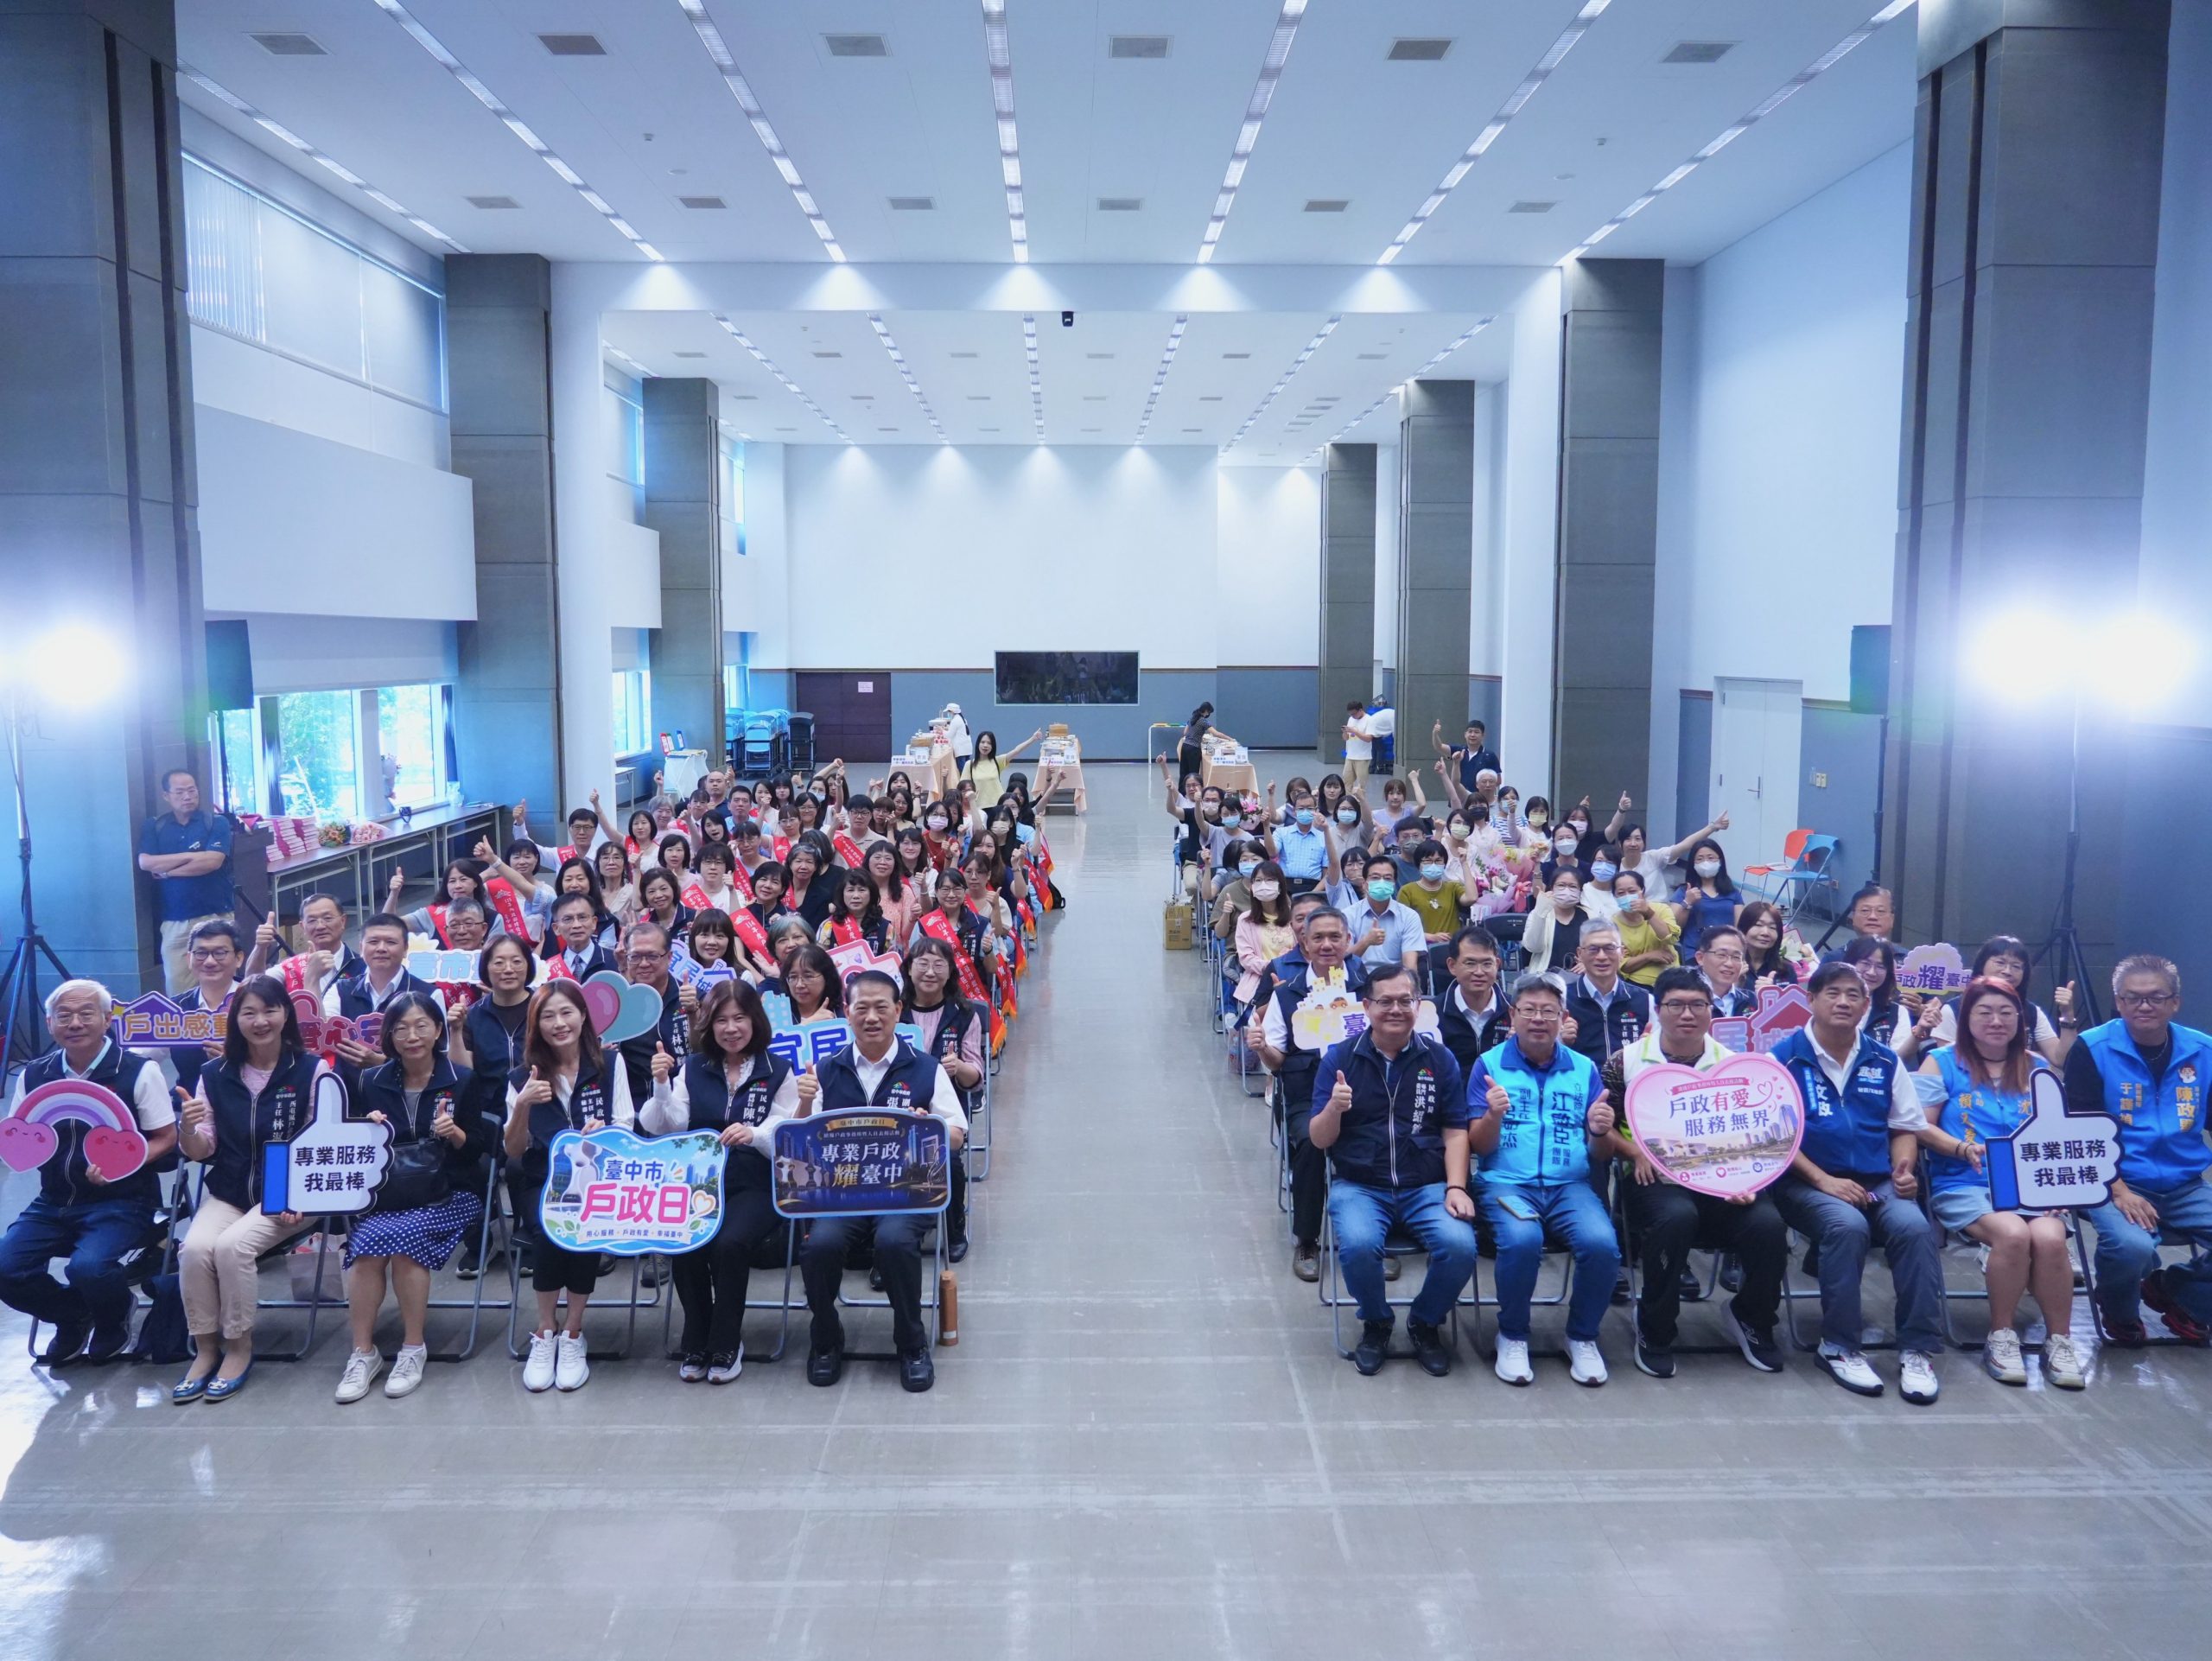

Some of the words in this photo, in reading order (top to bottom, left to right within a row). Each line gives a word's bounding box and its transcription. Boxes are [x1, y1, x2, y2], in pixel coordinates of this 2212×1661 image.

[1669, 1088, 1750, 1119] 戶政有愛
[1685, 1109, 1770, 1138] 服務無界
[295, 1144, 376, 1167] 專業服務
[821, 1142, 901, 1163] 專業戶政
[2019, 1139, 2106, 1162] 專業服務
[605, 1158, 664, 1181] 臺中市
[831, 1162, 902, 1188] 耀臺中
[2034, 1165, 2099, 1187] 我最棒
[303, 1171, 365, 1193] 我最棒
[580, 1182, 689, 1224] 戶政日
